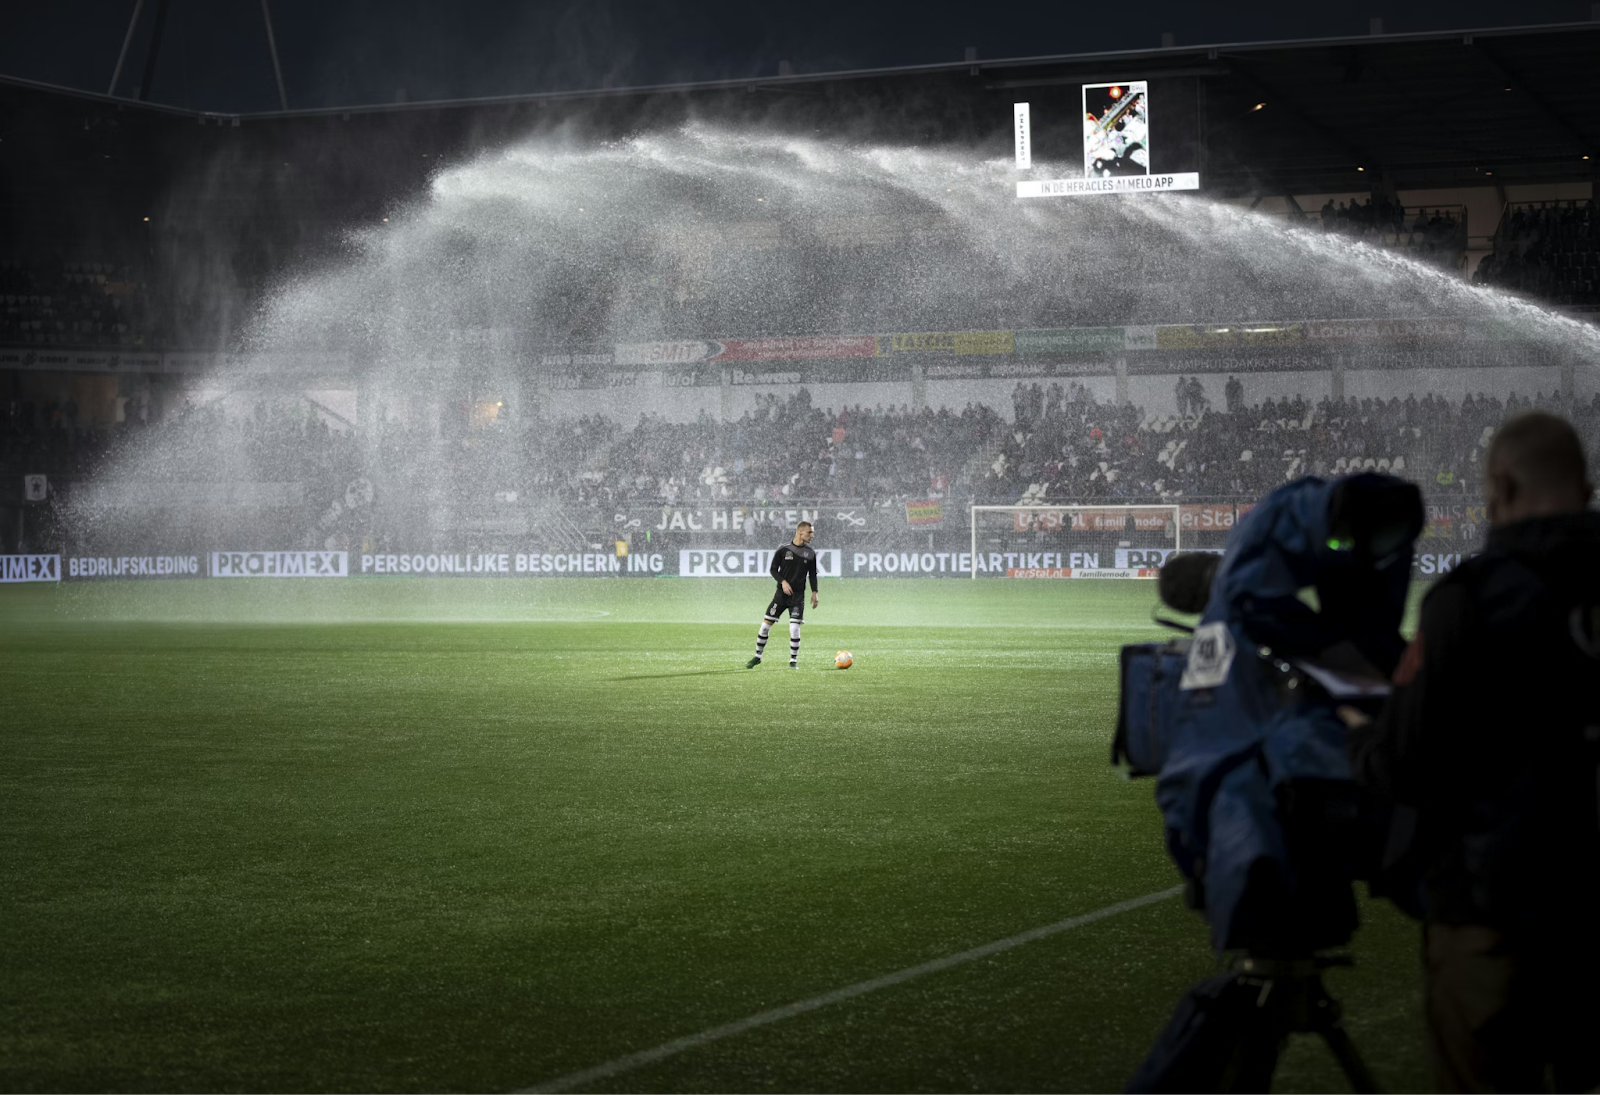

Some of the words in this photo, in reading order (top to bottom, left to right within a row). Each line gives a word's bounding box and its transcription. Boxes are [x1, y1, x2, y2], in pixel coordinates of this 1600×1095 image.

[1041, 183, 1051, 193] IN
[1053, 182, 1065, 192] DE
[1066, 179, 1114, 192] HERACLES
[1154, 176, 1174, 188] APP
[1095, 511, 1163, 526] familimode
[69, 555, 199, 576] BEDRIJFSKLEDING
[218, 552, 338, 575] PROFIMEX
[361, 553, 509, 572] PERSOONLIJKE
[1014, 568, 1063, 578] terStal.nl
[1079, 569, 1130, 579] familiemode
